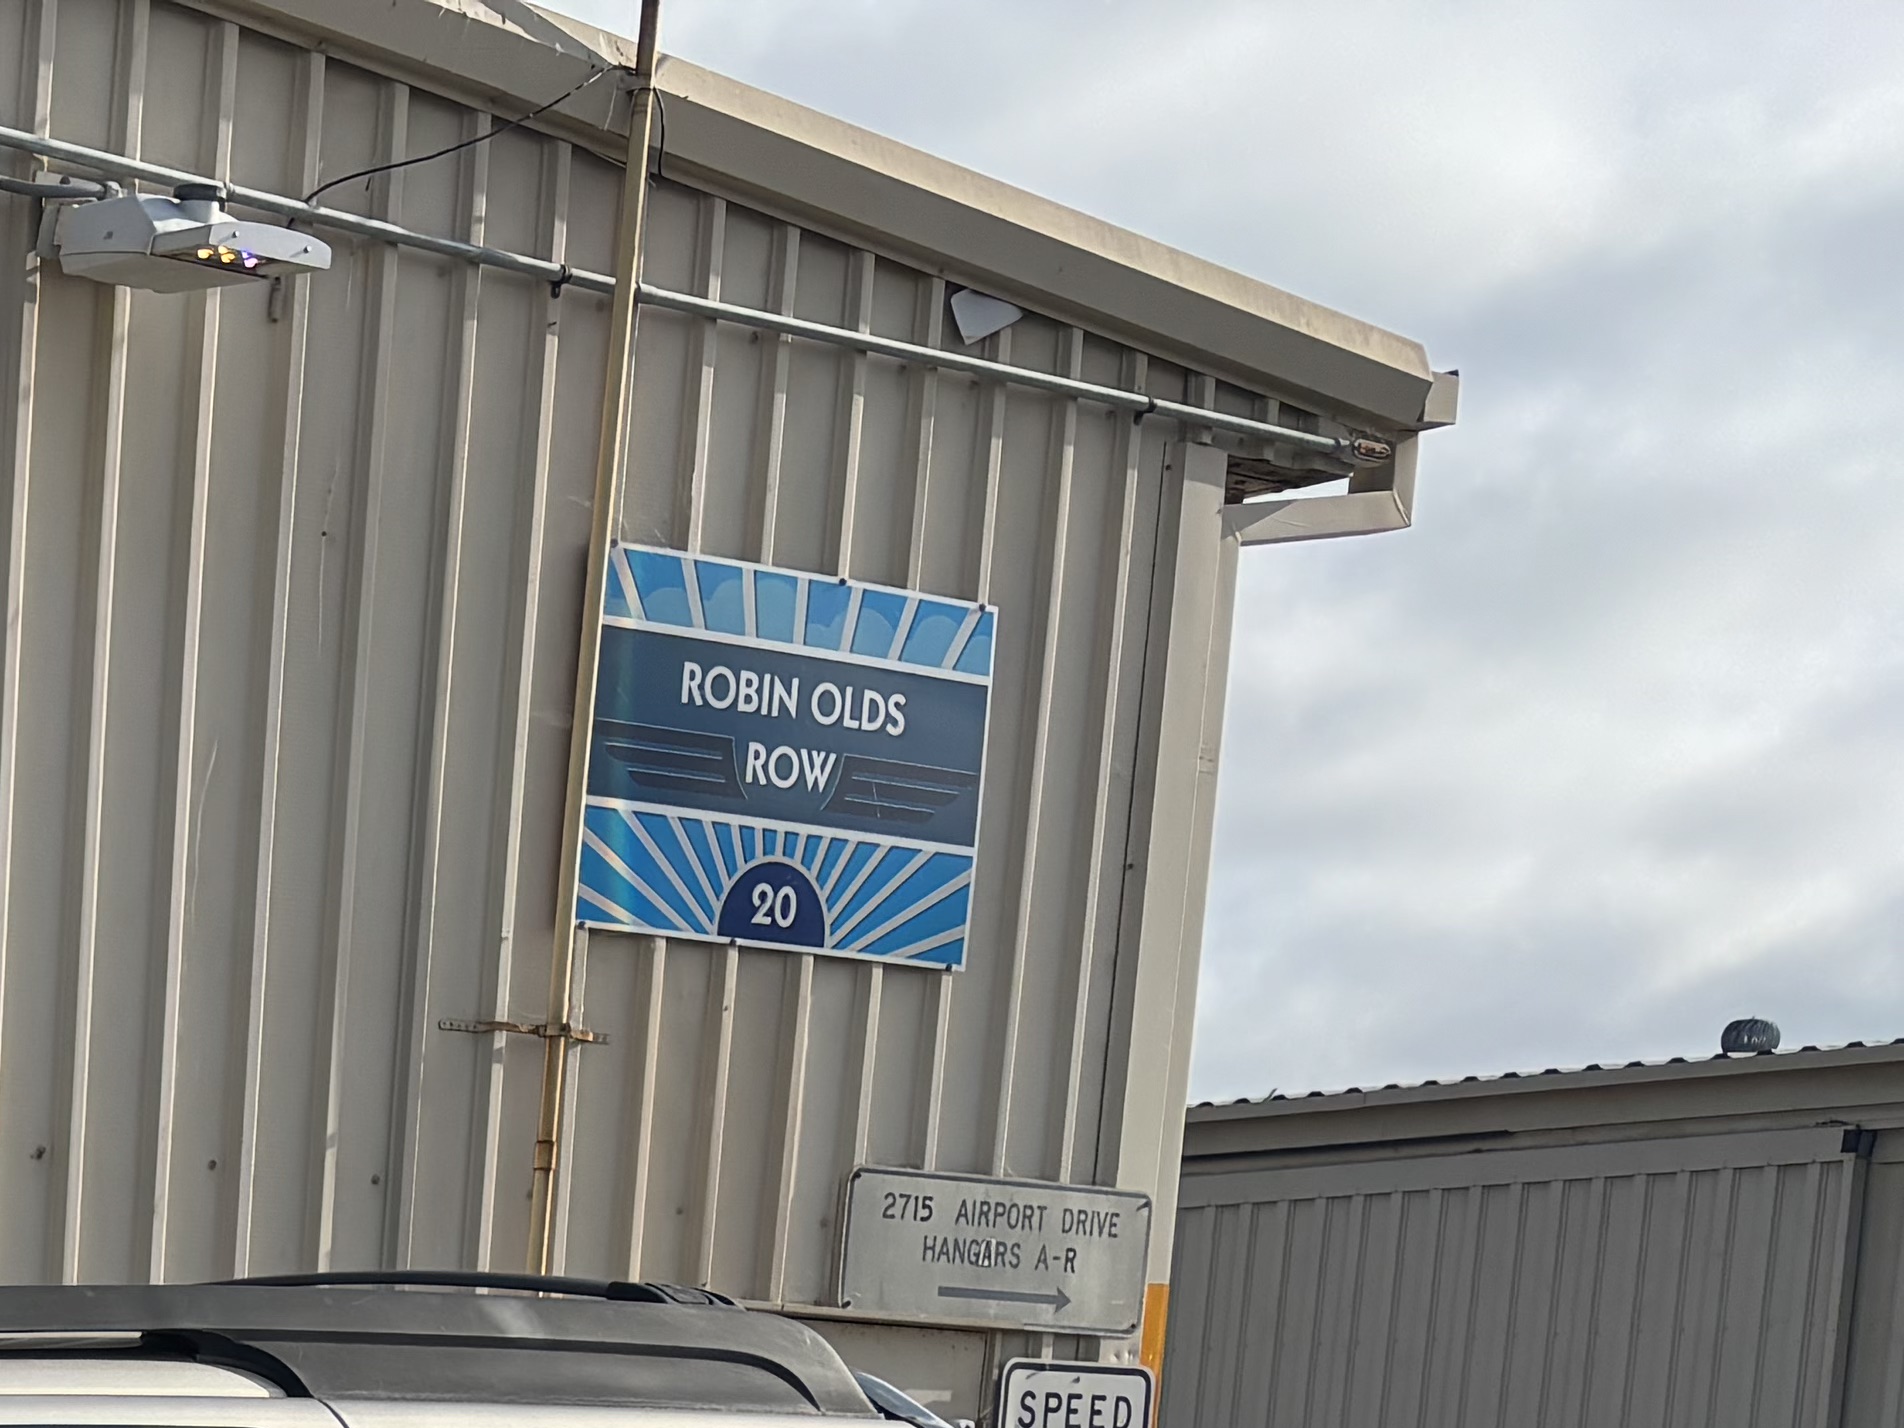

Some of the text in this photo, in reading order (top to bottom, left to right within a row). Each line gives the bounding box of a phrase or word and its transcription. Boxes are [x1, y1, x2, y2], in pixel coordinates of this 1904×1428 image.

[681, 661, 907, 736] ROBIN OLDS
[745, 741, 837, 793] ROW
[750, 882, 797, 928] 20
[882, 1192, 1121, 1238] 2715 AIRPORT DRIVE
[921, 1235, 1077, 1274] HANGARS A-R
